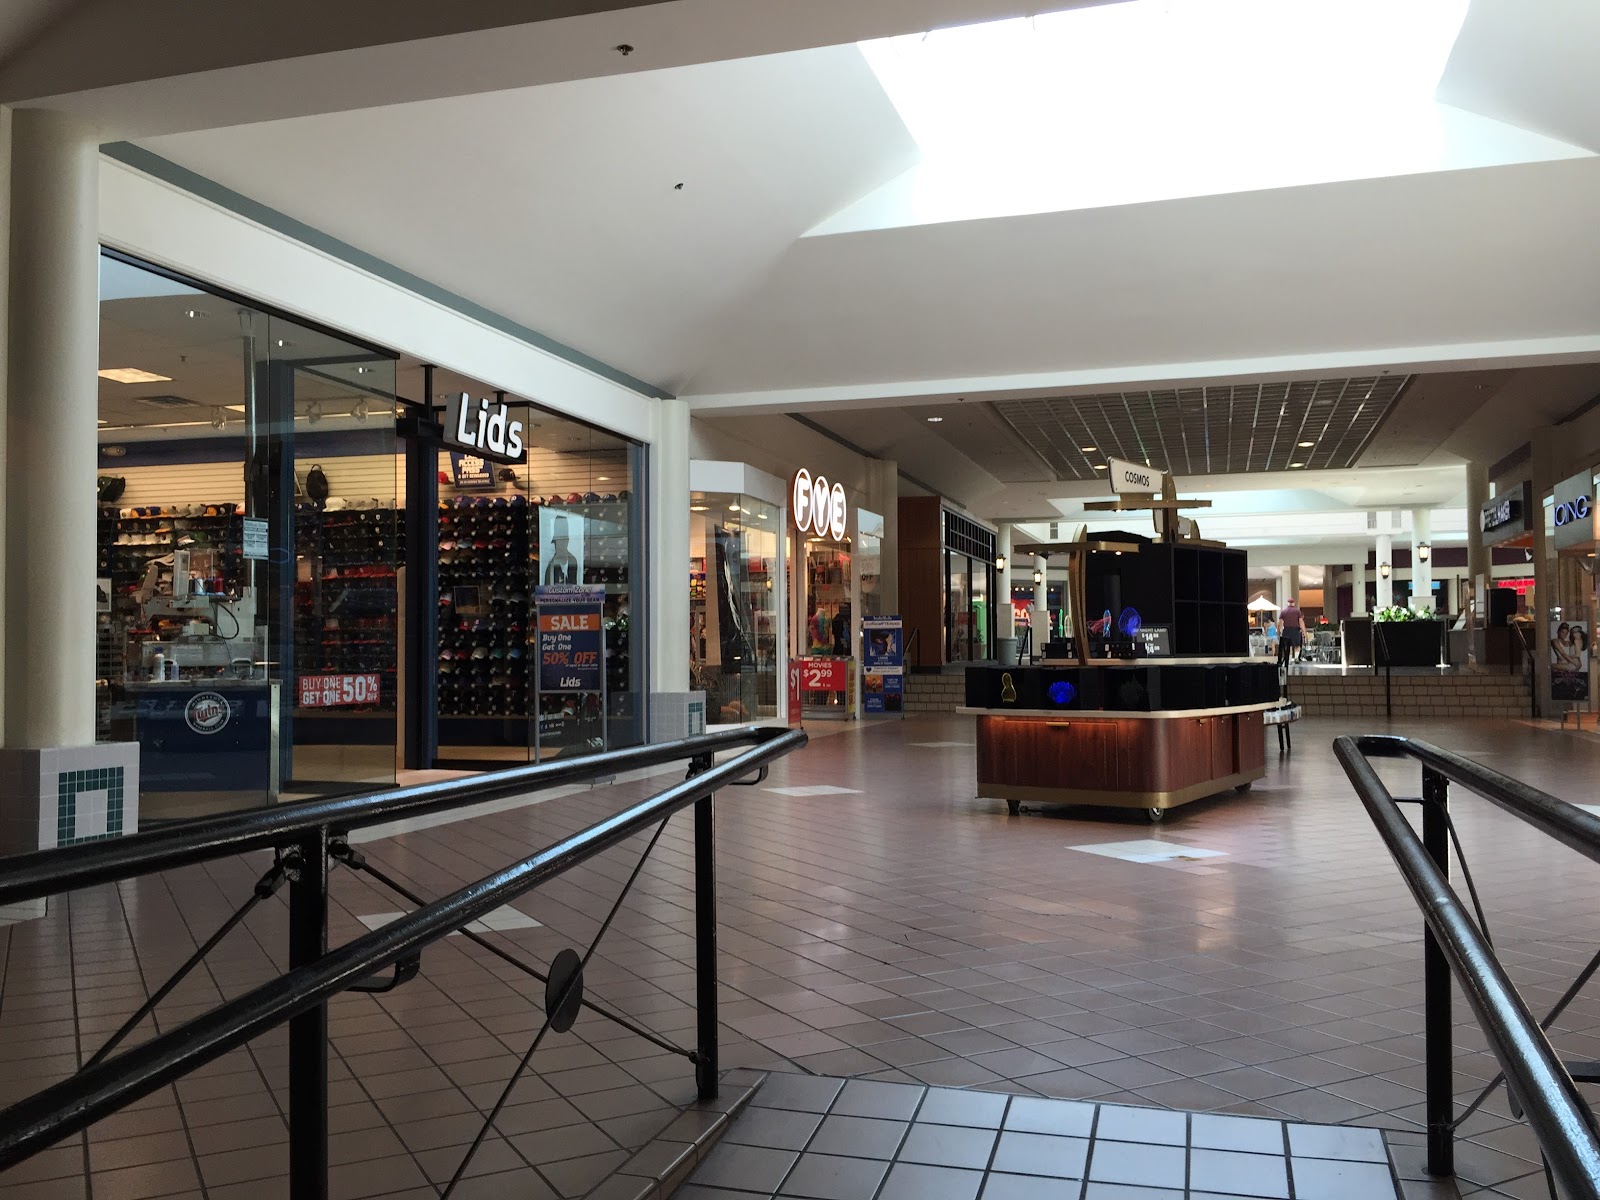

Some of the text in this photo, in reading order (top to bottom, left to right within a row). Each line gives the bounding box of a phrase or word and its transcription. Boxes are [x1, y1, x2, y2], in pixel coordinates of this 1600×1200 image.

[458, 392, 523, 458] Lids
[1125, 471, 1149, 487] COSMOS
[795, 473, 846, 538] FYE
[1554, 495, 1588, 526] ICING
[548, 585, 592, 594] Custom Zone
[550, 615, 589, 631] SALE
[542, 633, 557, 643] Buy
[542, 643, 554, 651] Get
[543, 652, 597, 665] 50% OFF
[302, 677, 340, 690] BUY ONE
[343, 676, 378, 702] 50%
[560, 677, 581, 687] Lids
[790, 668, 800, 700] $1
[192, 695, 223, 706] MINNESOTA
[302, 690, 340, 704] GET ONE
[192, 704, 225, 722] Twins
